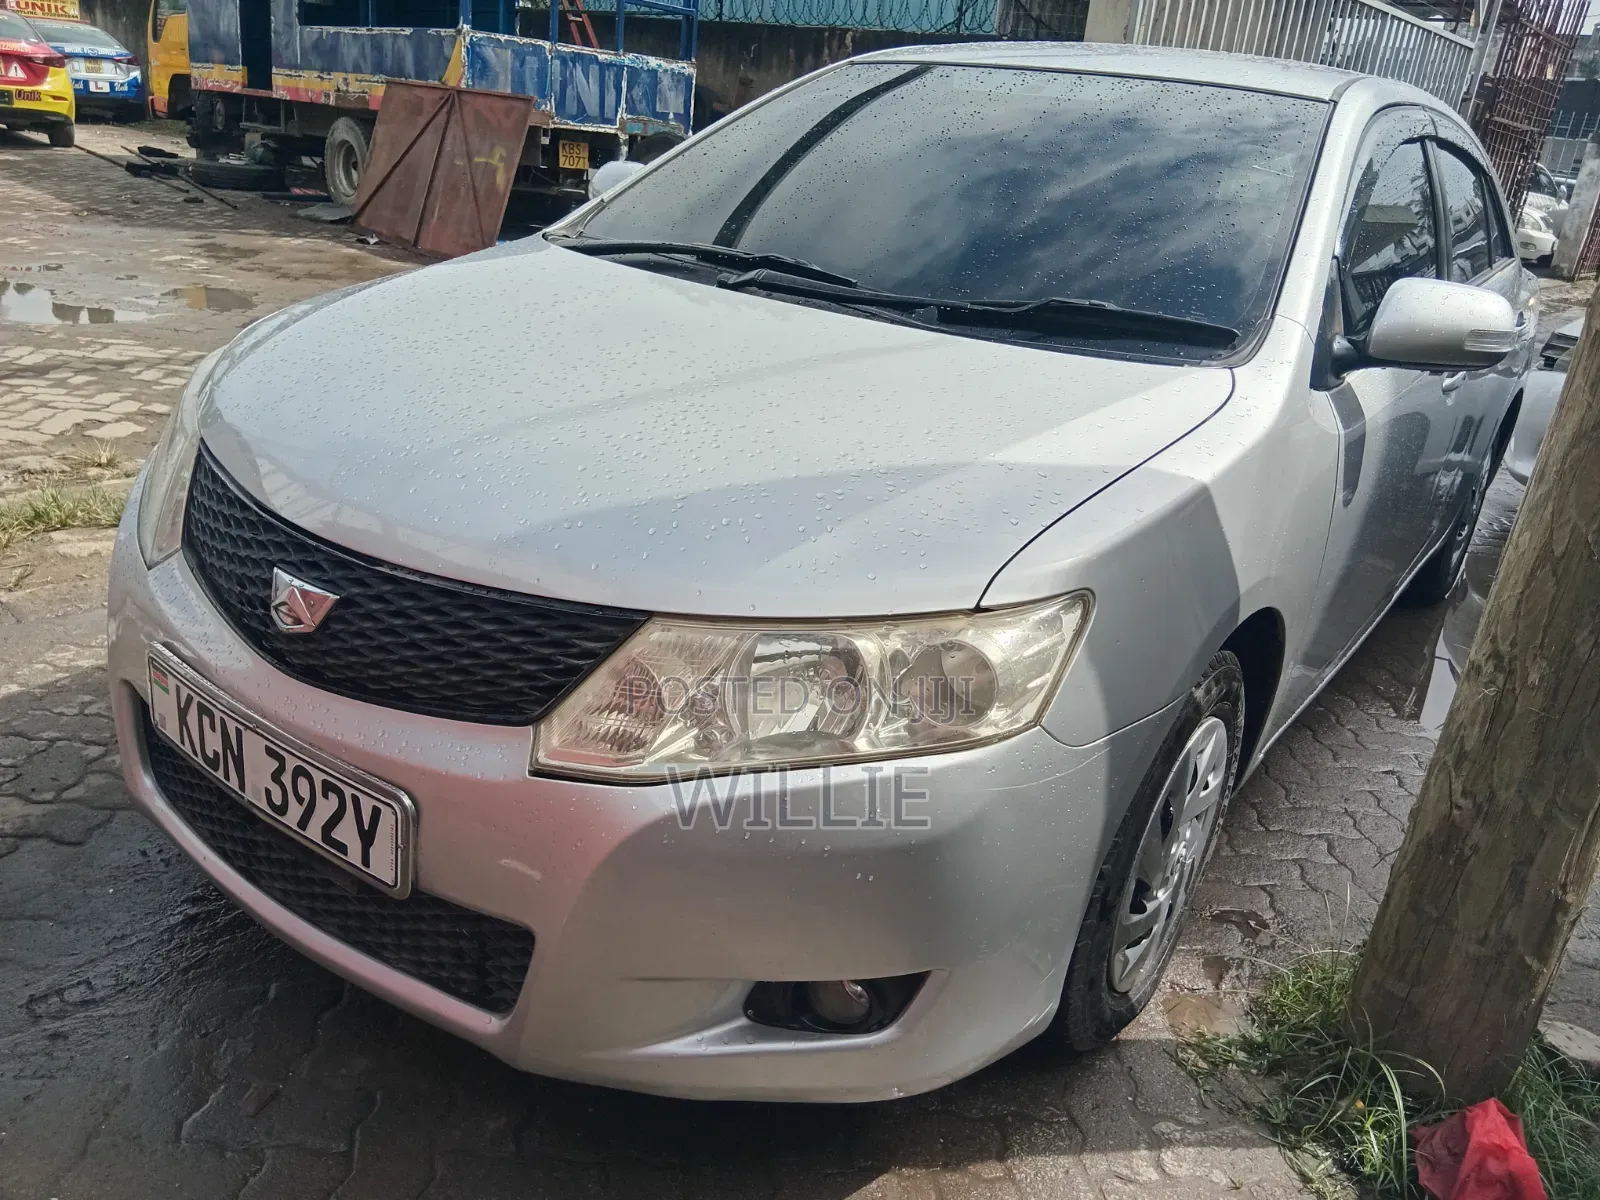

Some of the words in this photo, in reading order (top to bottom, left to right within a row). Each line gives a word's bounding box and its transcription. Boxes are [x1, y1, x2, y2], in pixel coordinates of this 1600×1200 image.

[15, 0, 69, 15] UNIK
[95, 81, 103, 91] L
[15, 89, 42, 102] Unik
[561, 142, 581, 155] KBS
[561, 155, 587, 168] 707T
[175, 683, 246, 794] KCN
[264, 743, 383, 870] 392Y
